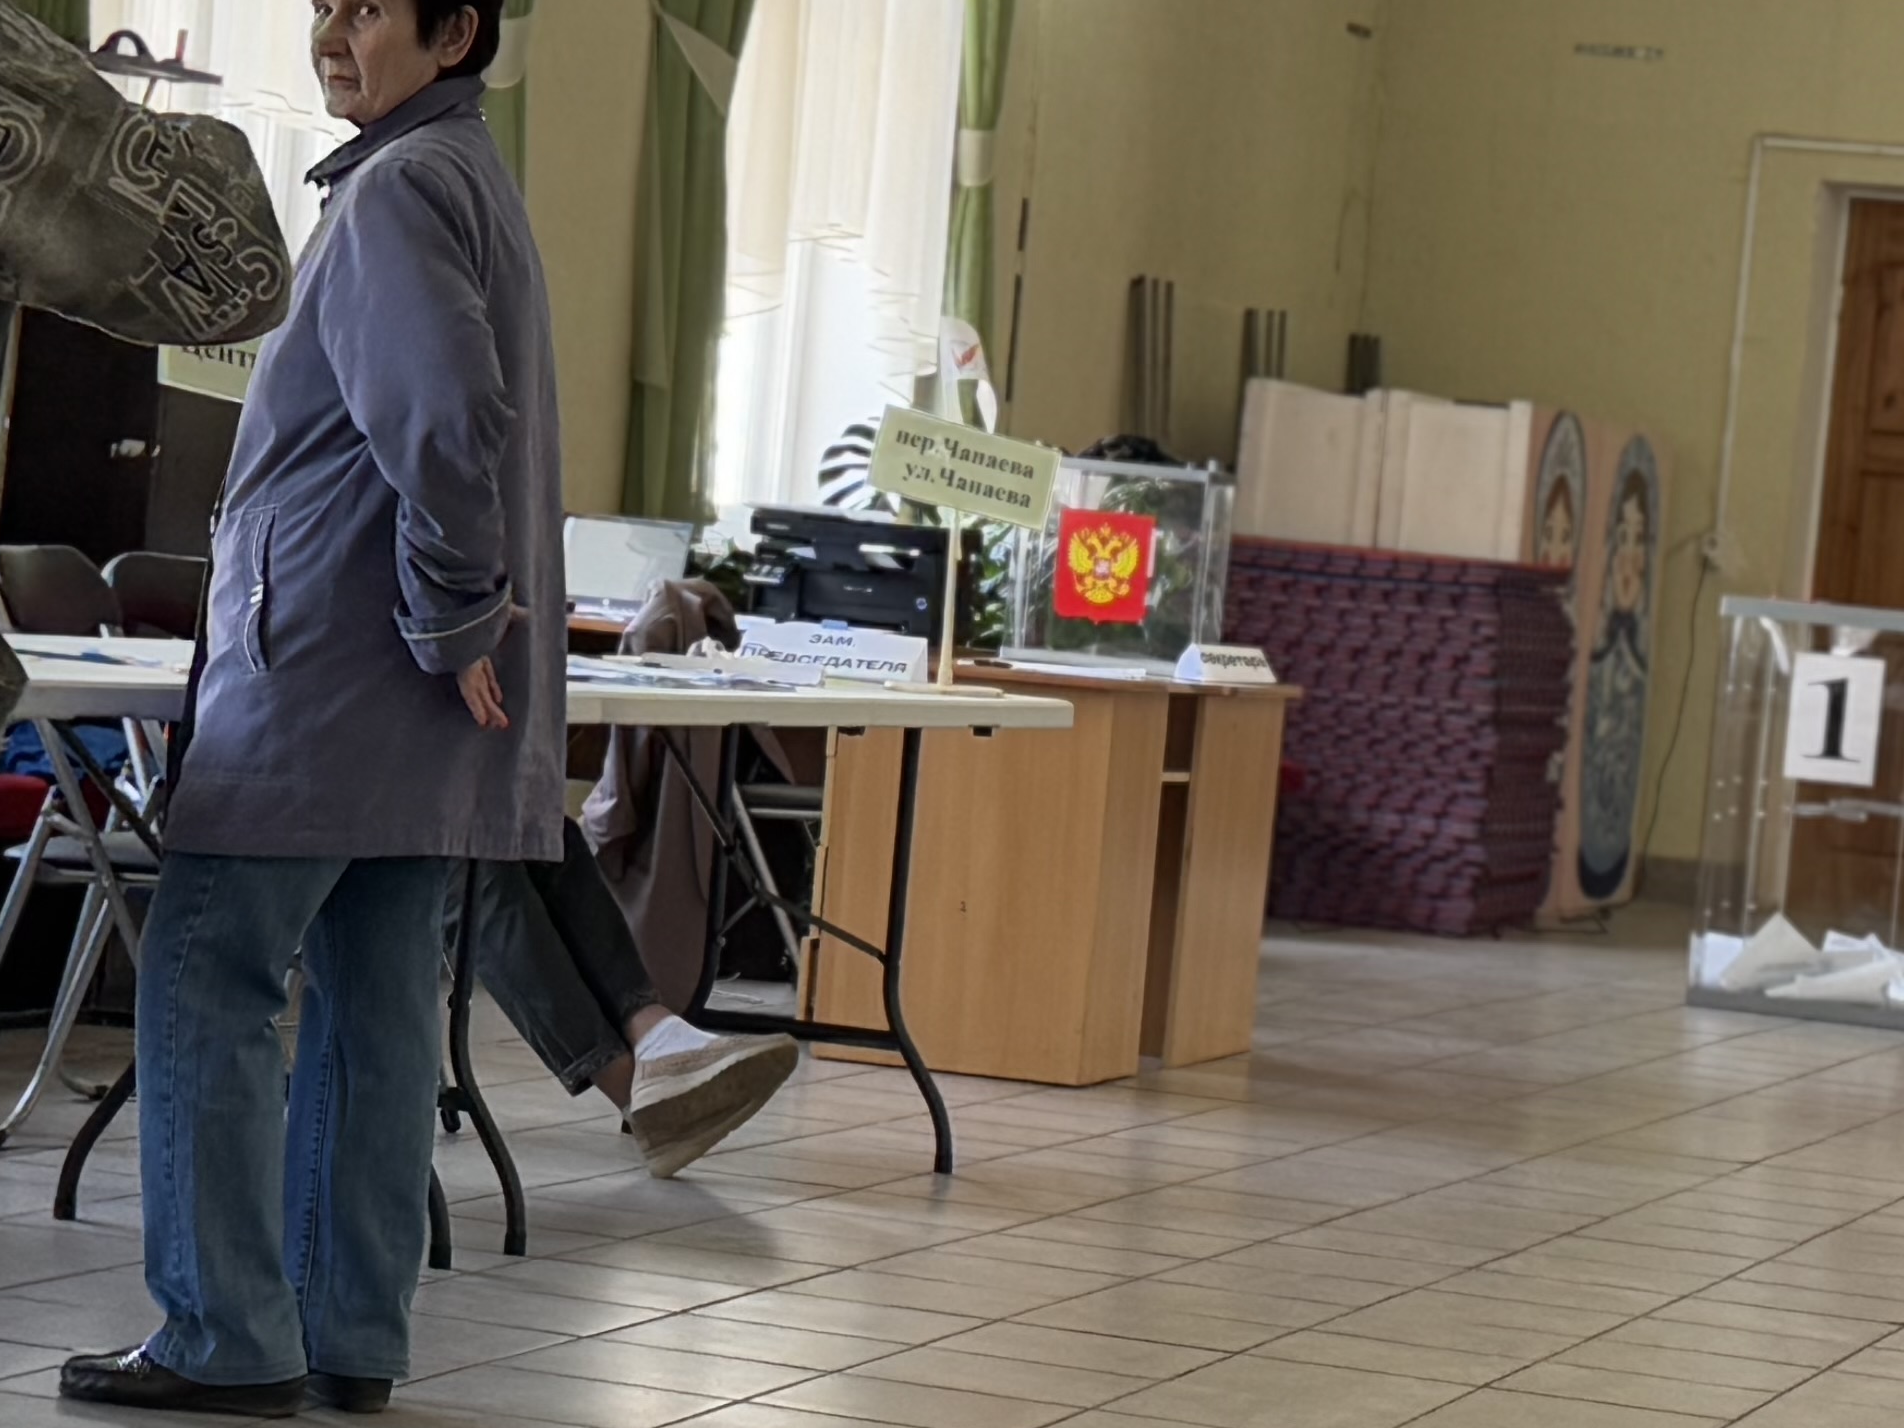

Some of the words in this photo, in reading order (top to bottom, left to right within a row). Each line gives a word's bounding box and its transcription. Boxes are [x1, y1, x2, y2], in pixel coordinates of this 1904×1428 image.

[896, 429, 940, 456] пер.
[944, 438, 1035, 480] Чапаева
[902, 463, 935, 483] ул.
[940, 467, 1032, 509] Чапаева
[1807, 677, 1862, 764] 1
